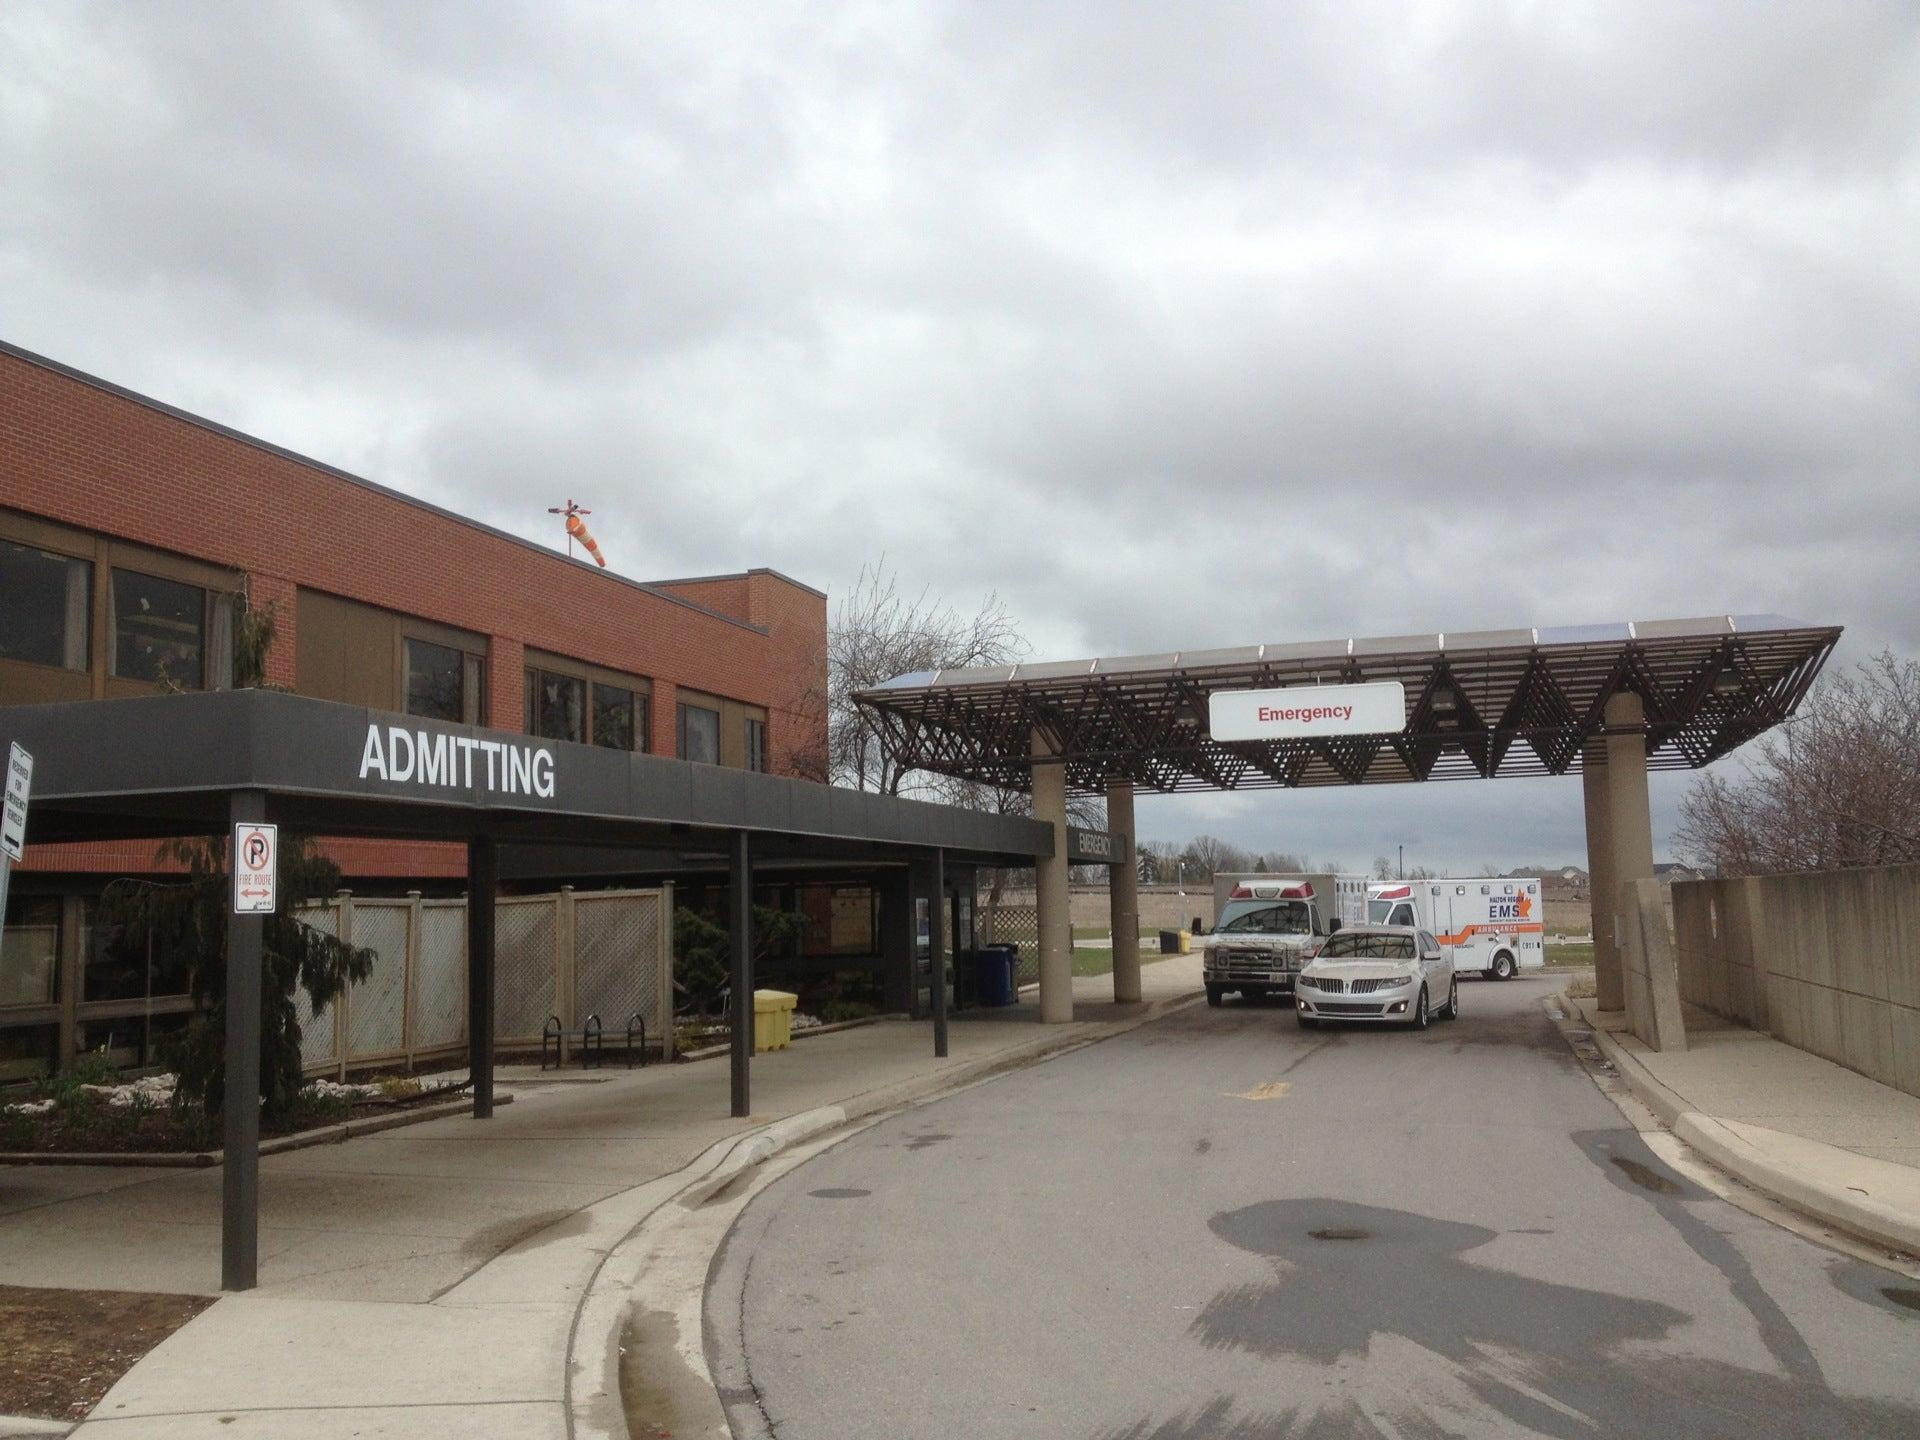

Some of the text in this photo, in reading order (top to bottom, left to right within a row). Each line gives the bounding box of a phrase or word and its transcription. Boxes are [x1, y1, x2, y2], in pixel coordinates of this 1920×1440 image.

[1258, 706, 1352, 723] Emergency
[359, 724, 554, 797] ADMITTING
[1079, 832, 1111, 856] EMERGENCY
[239, 873, 272, 886] FIRE ROUTE
[1489, 896, 1507, 904] HALTON
[1489, 905, 1520, 918] EMS
[1477, 925, 1518, 933] AMBULANCE
